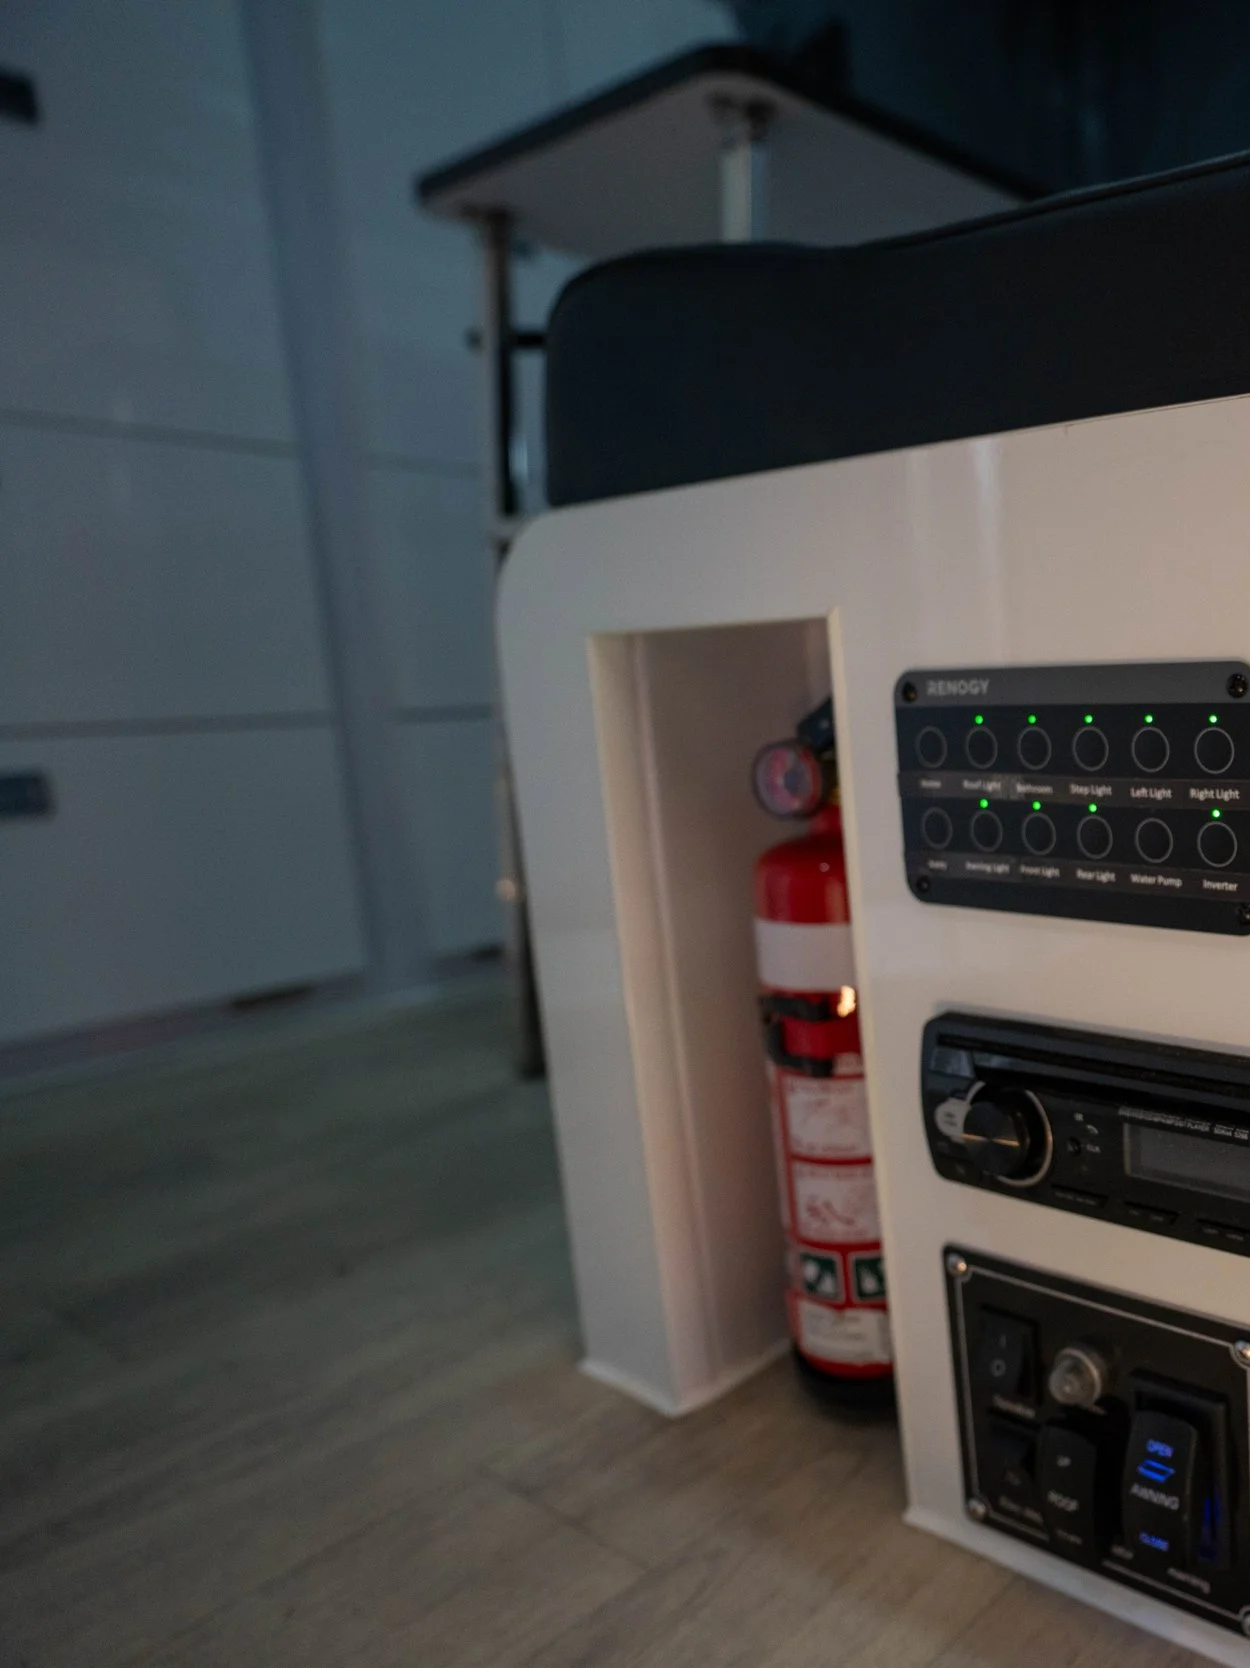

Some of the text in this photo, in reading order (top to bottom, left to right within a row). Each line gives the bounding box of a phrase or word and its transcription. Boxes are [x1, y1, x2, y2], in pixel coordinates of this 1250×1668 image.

[926, 678, 990, 696] RENOGY
[1069, 783, 1112, 797] Step Light
[1130, 787, 1172, 800] Left Light
[1190, 788, 1240, 802] Right Light
[1076, 868, 1116, 884] Rear Light
[1130, 873, 1182, 888] Water Pump
[1202, 879, 1238, 892] Inverter
[1130, 1482, 1180, 1511] AWNING
